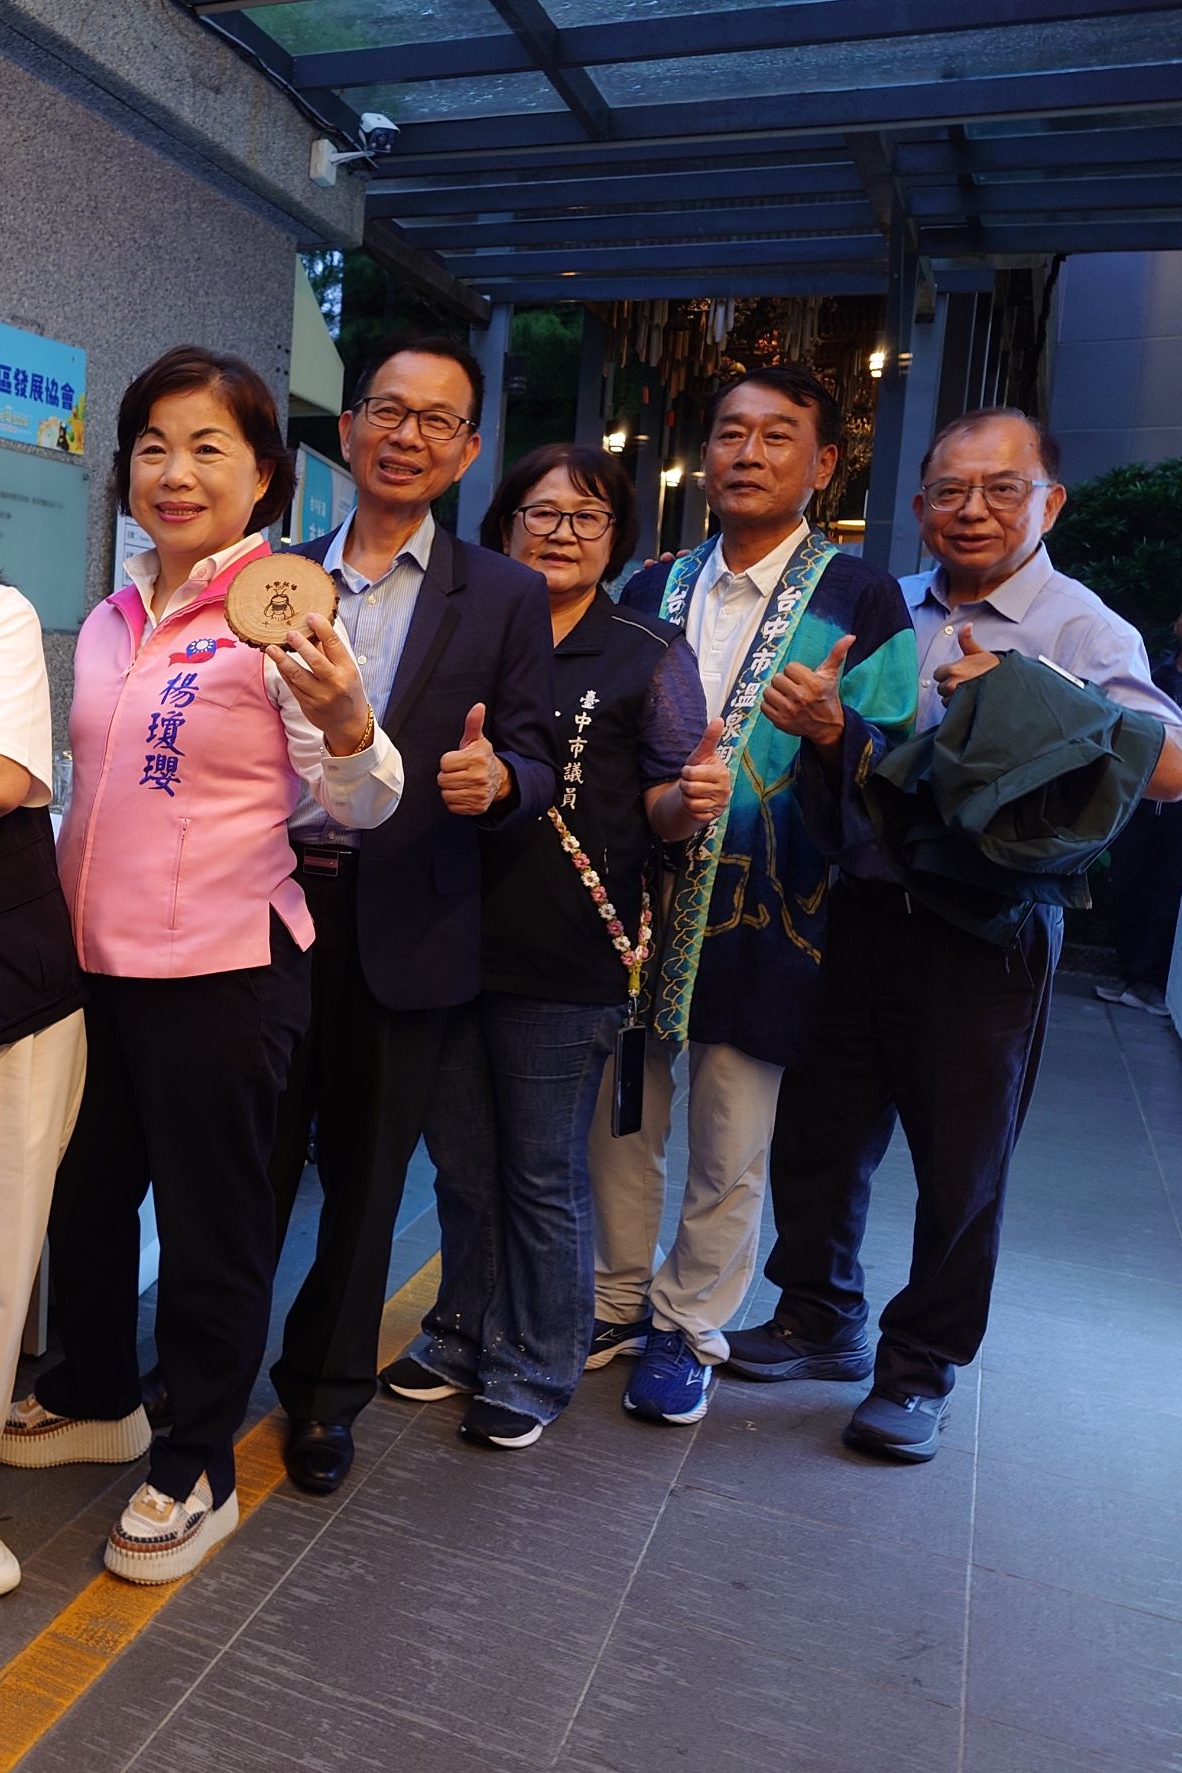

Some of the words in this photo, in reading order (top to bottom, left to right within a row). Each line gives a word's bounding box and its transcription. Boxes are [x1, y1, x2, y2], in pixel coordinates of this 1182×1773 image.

[139, 672, 199, 797] 楊瓊瓔
[560, 690, 600, 810] 臺中市議員
